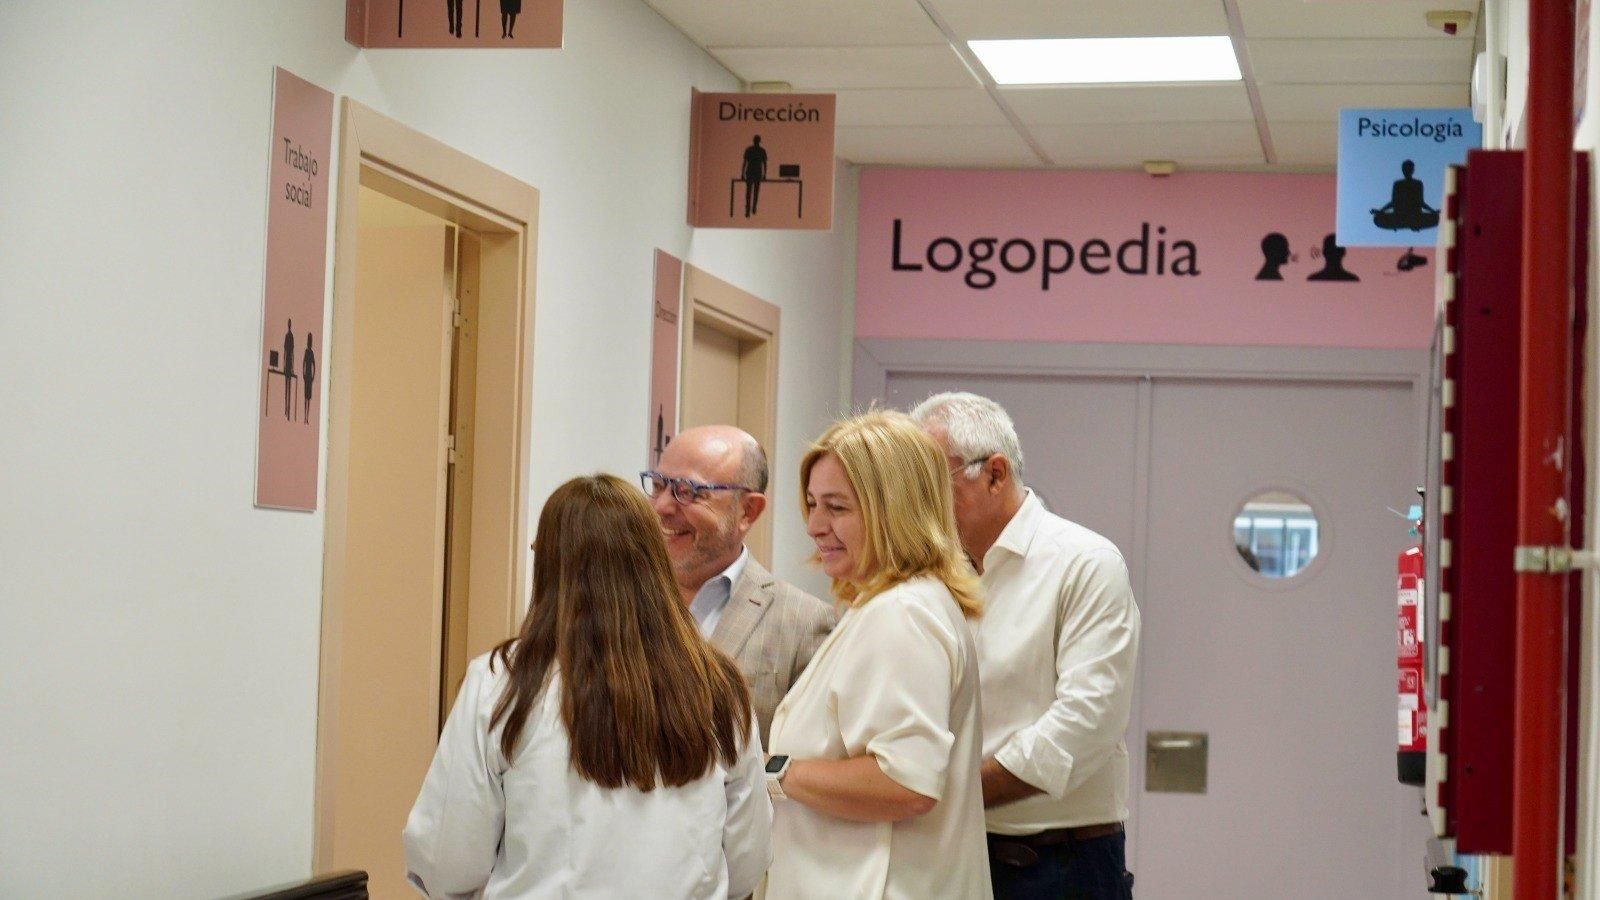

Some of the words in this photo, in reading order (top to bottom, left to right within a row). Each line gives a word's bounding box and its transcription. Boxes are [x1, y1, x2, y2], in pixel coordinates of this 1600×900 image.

[719, 101, 820, 122] Dirección
[1358, 116, 1463, 143] Psicología
[283, 136, 318, 181] Trabajo
[285, 181, 313, 208] social
[892, 219, 1200, 291] Logopedia
